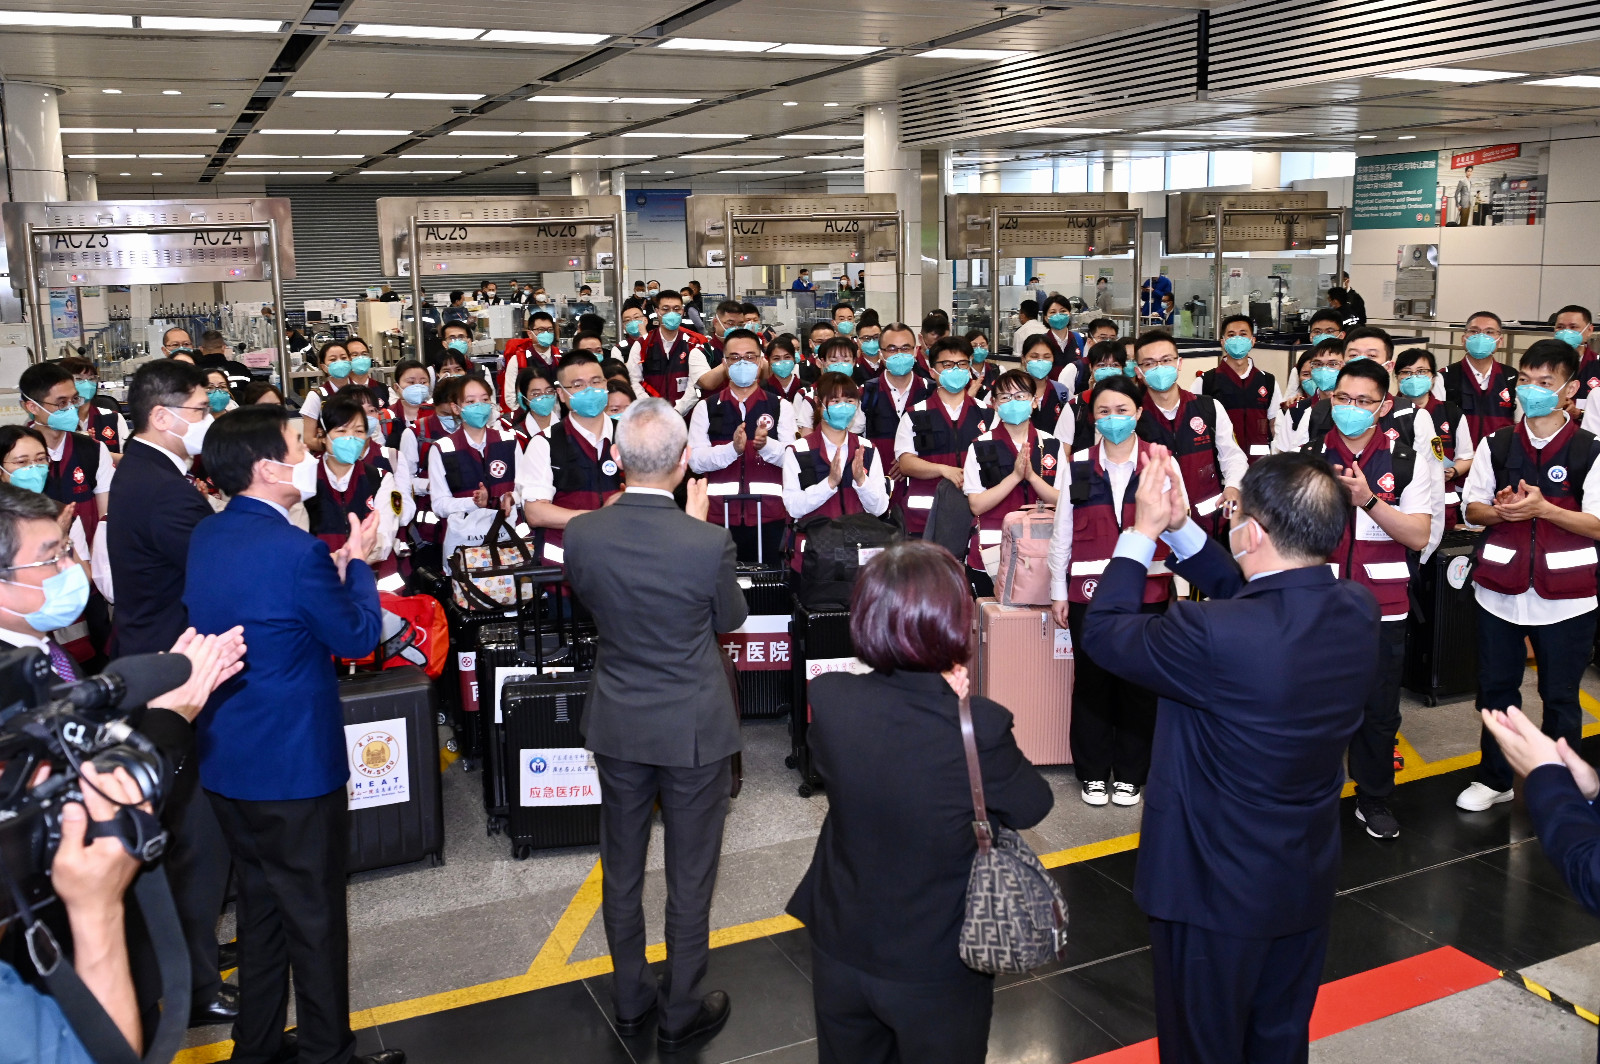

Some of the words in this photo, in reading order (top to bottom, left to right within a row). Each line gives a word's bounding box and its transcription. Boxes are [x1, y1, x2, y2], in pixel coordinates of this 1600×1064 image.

[537, 225, 577, 238] AC26
[825, 220, 859, 233] AC28
[193, 231, 243, 246] AC24
[425, 227, 468, 240] AC25
[55, 233, 109, 249] AC23
[723, 641, 789, 662] 方医院
[530, 785, 593, 798] 应急医疗队
